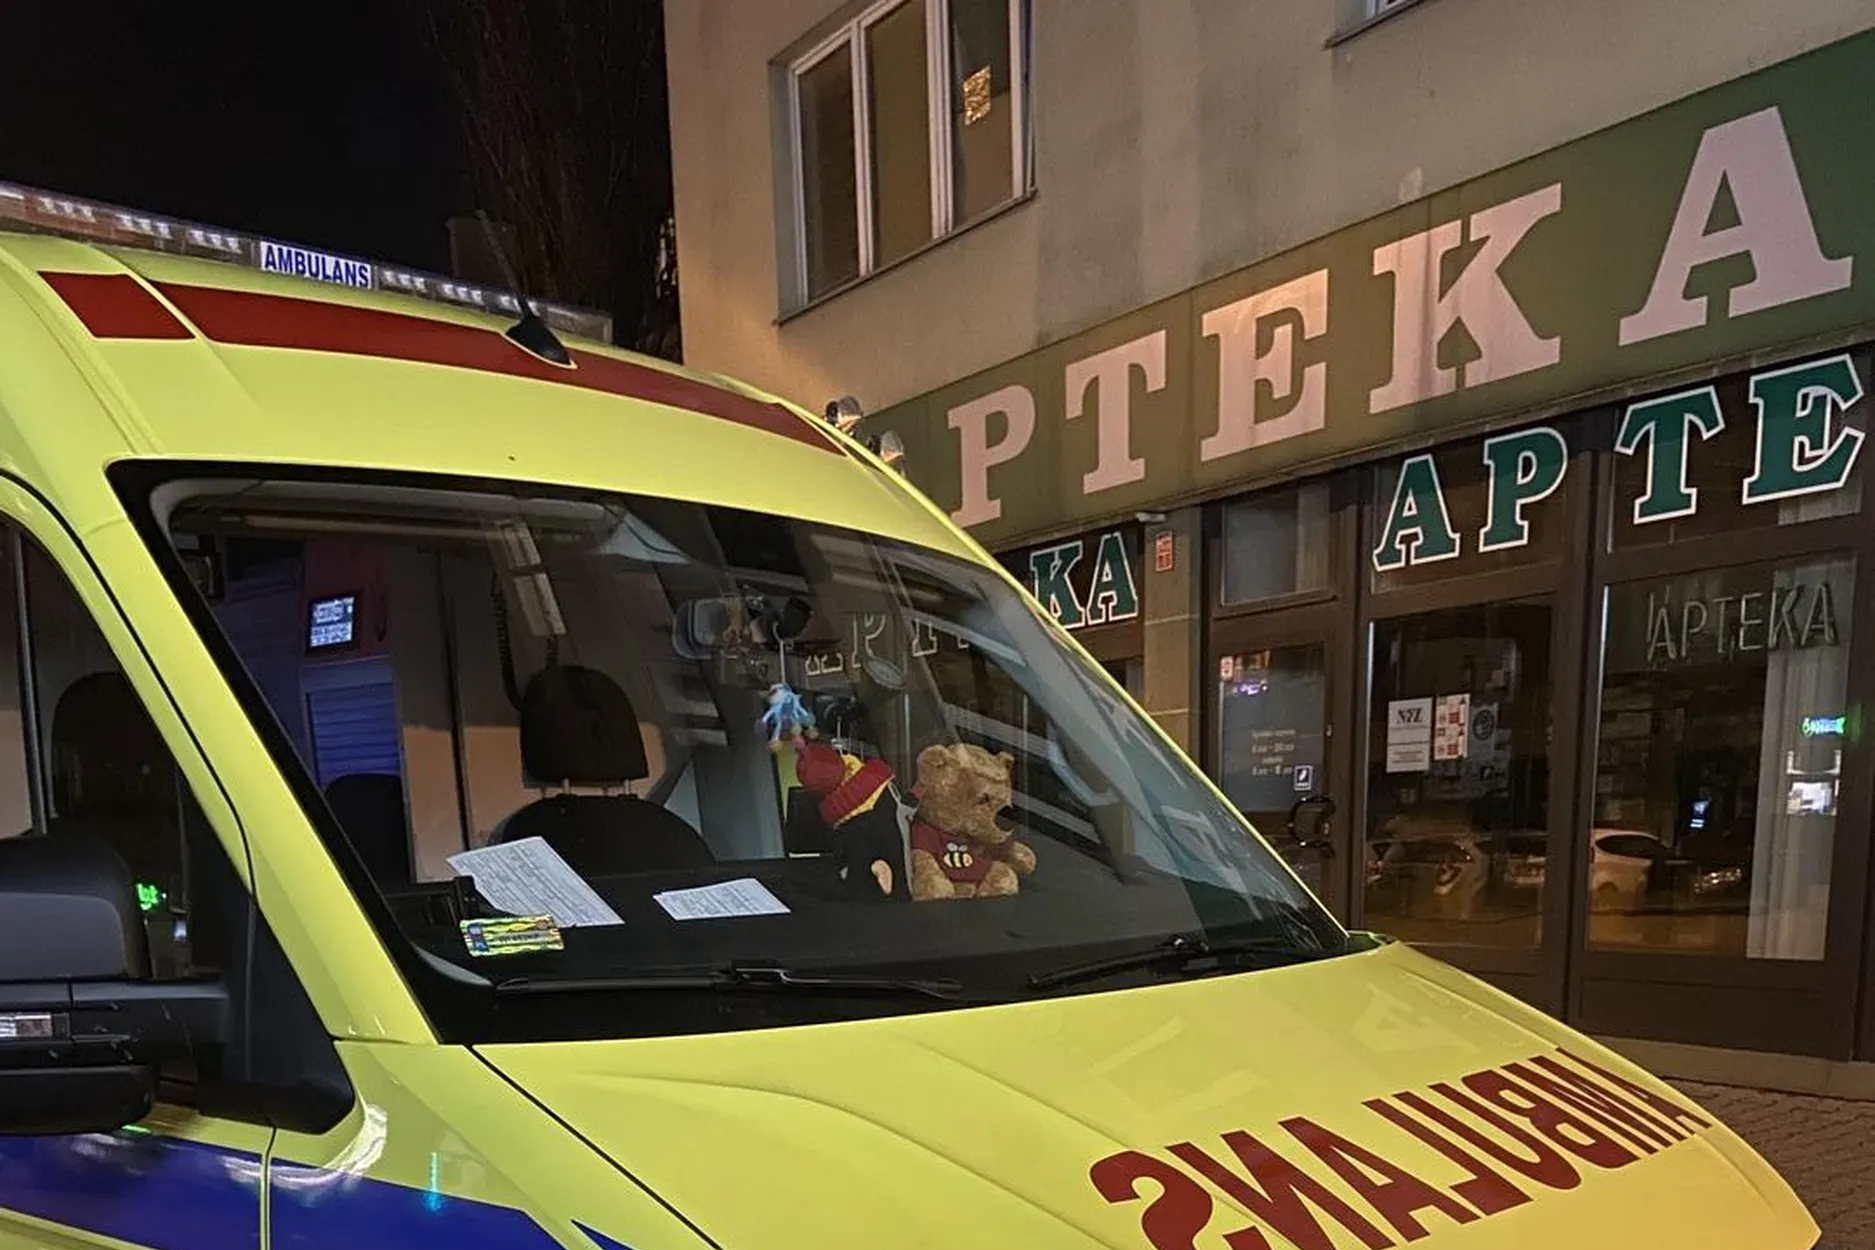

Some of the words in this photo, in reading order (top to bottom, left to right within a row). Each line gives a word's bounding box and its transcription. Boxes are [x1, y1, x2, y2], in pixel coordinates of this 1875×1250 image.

[264, 244, 370, 288] AMBULANS
[1372, 354, 1866, 571] APTE
[1030, 532, 1138, 629] KA
[1646, 580, 1841, 663] APTEKA
